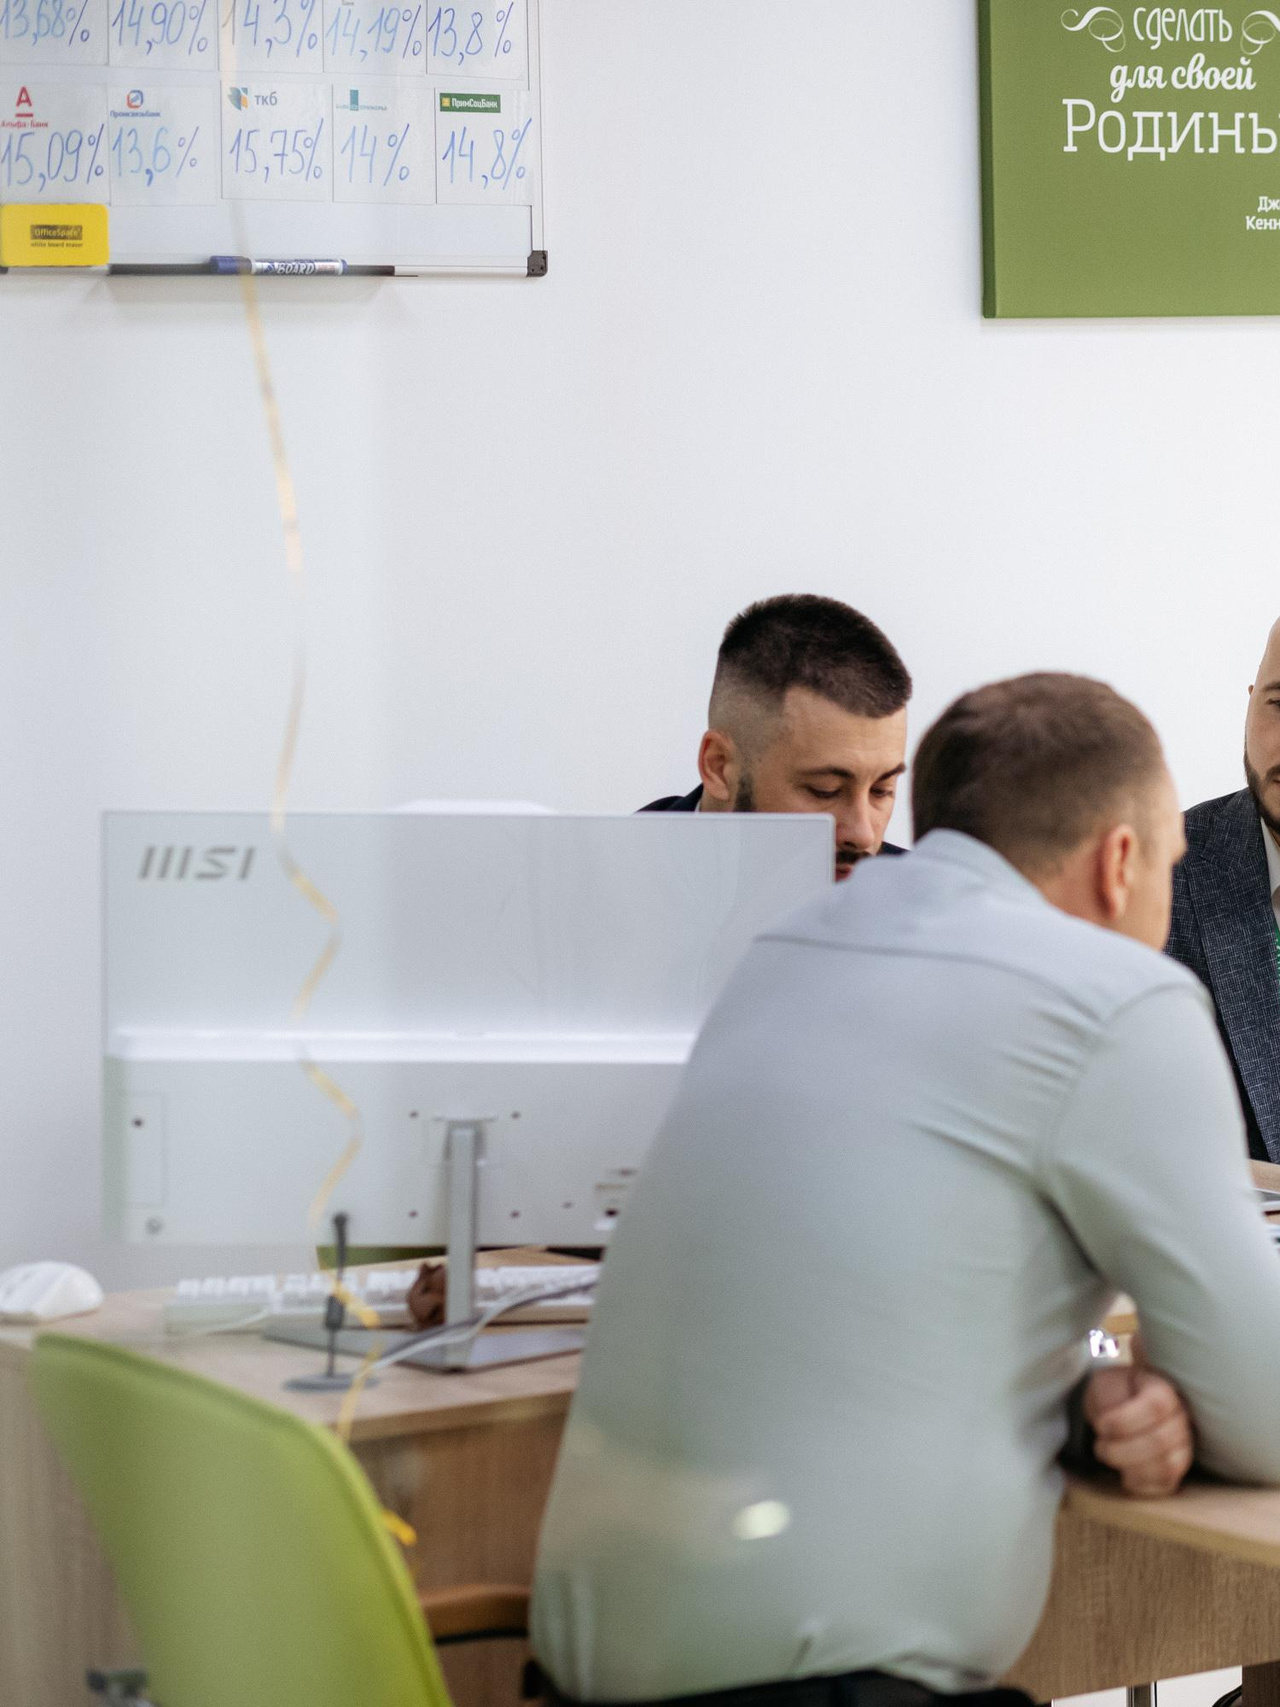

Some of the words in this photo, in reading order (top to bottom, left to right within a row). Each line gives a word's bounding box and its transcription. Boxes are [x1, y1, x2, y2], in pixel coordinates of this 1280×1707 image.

[111, 0, 209, 56] 14,90%
[325, 4, 423, 62] 14,19%
[1132, 6, 1234, 50] сделать
[451, 97, 499, 110] ПримСоцБанк
[1109, 64, 1168, 103] для
[1170, 52, 1257, 91] своей
[0, 123, 105, 193] 15,09%
[112, 125, 200, 188] 13,6%
[229, 117, 325, 184] 15,75%
[341, 122, 411, 187] 14%
[442, 117, 533, 191] 14,8%
[277, 261, 315, 275] BOARD
